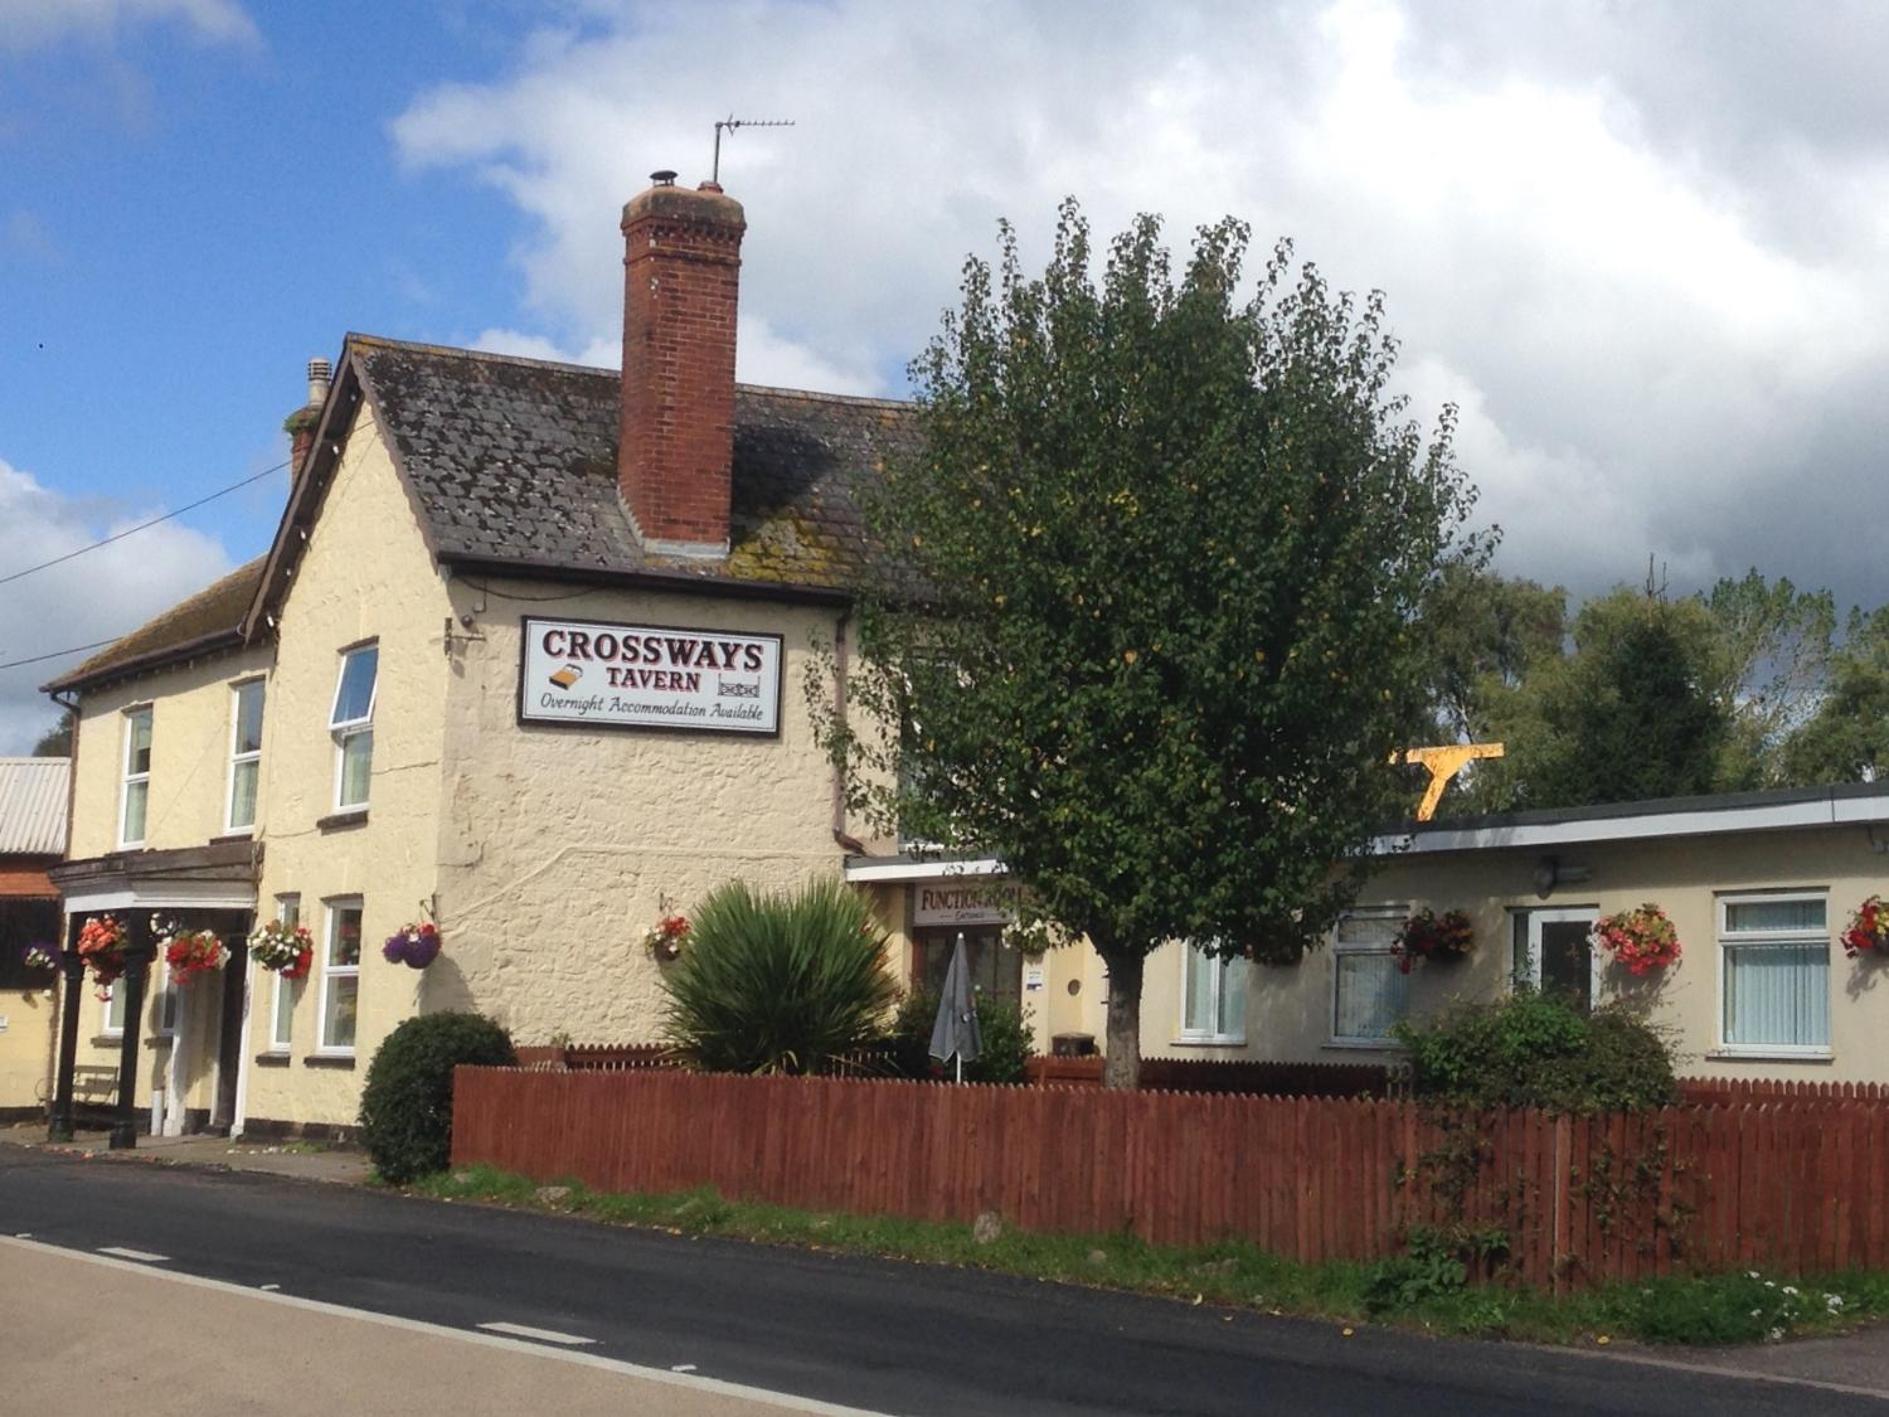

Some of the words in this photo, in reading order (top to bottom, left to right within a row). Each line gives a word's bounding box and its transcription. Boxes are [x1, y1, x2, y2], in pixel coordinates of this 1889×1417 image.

[542, 630, 764, 672] CROSSWAYS
[606, 666, 701, 692] TAVERN
[540, 692, 604, 716] Overnight
[608, 696, 706, 717] Accommodation
[710, 702, 763, 720] Available
